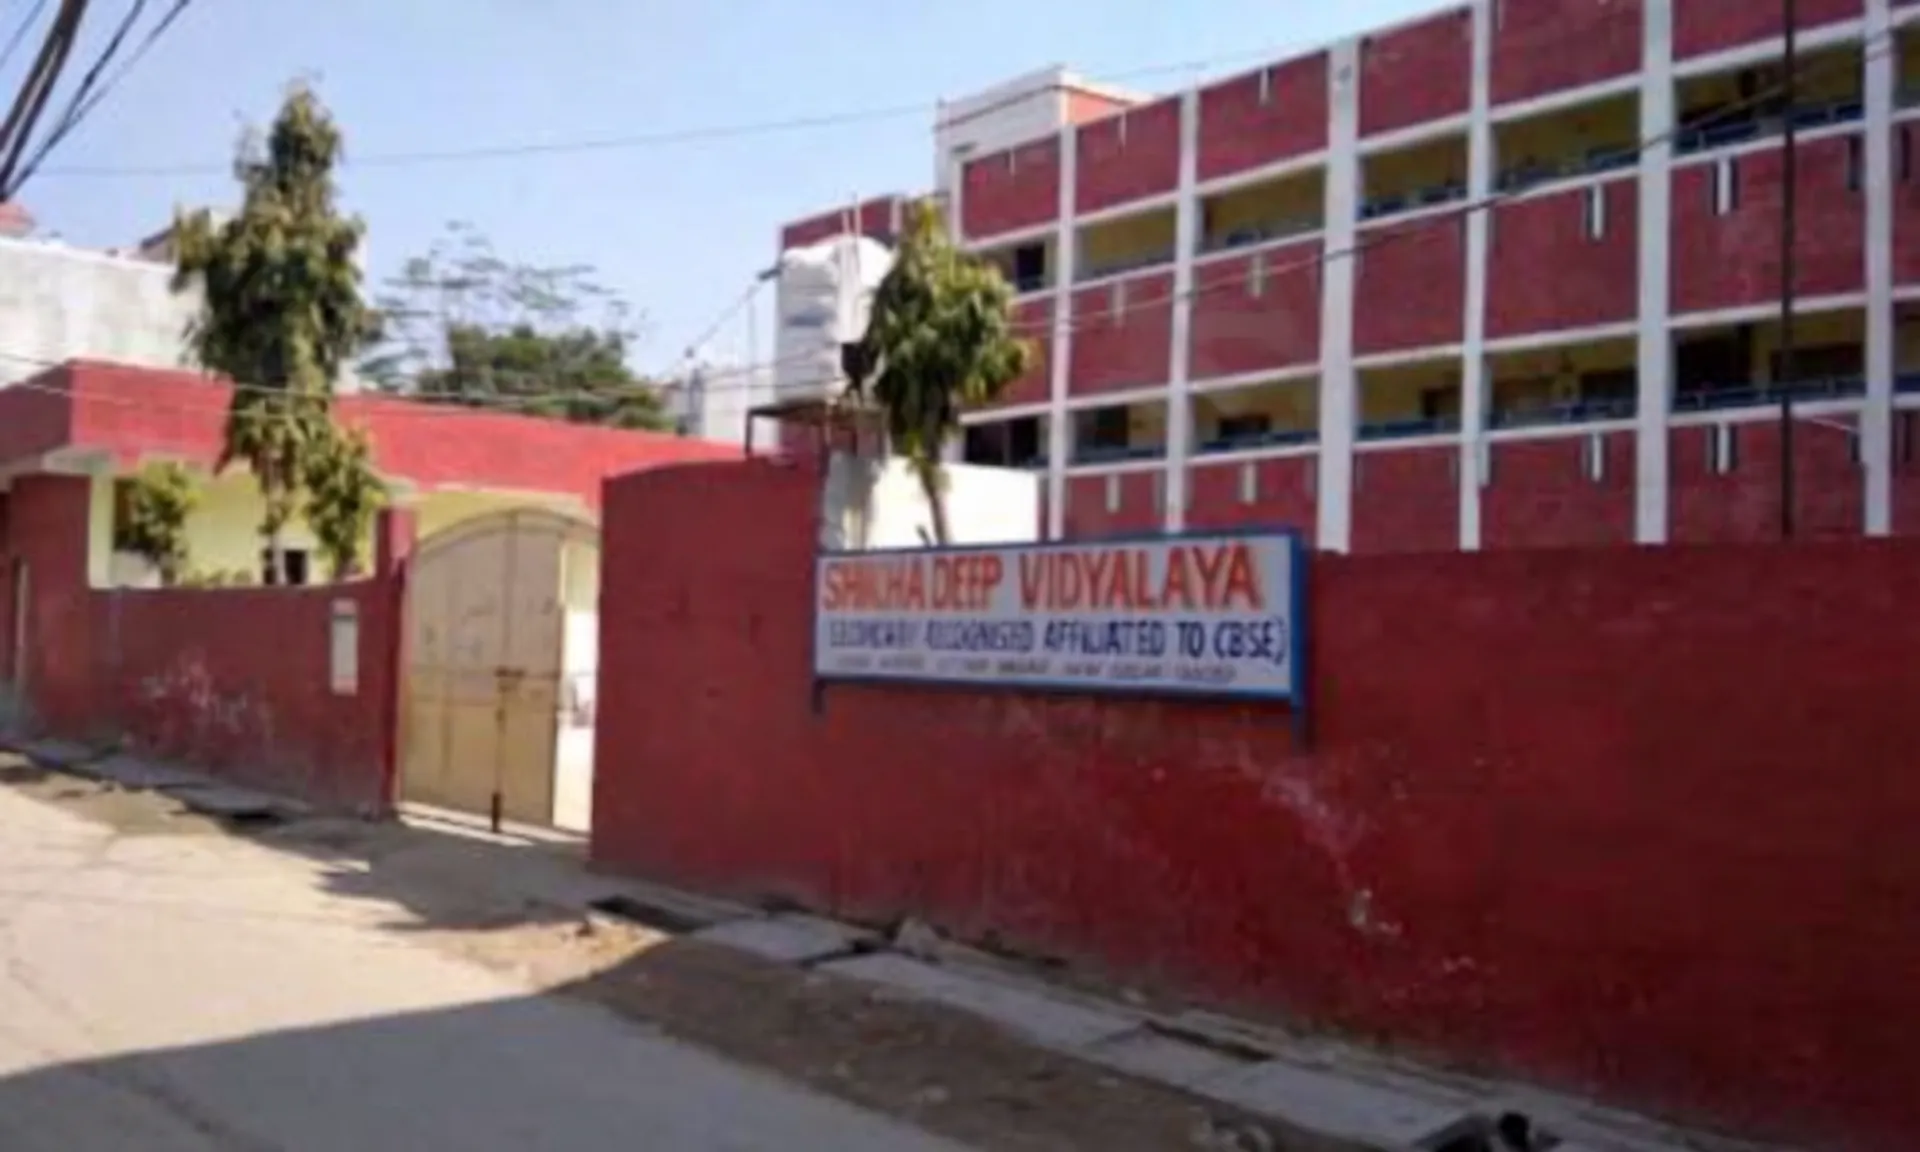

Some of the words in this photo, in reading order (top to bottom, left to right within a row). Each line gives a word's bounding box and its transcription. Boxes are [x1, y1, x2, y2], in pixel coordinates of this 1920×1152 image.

[1018, 542, 1265, 612] VIDYALAYA
[1044, 619, 1166, 657] AFFILIATED
[1177, 620, 1205, 658] TO
